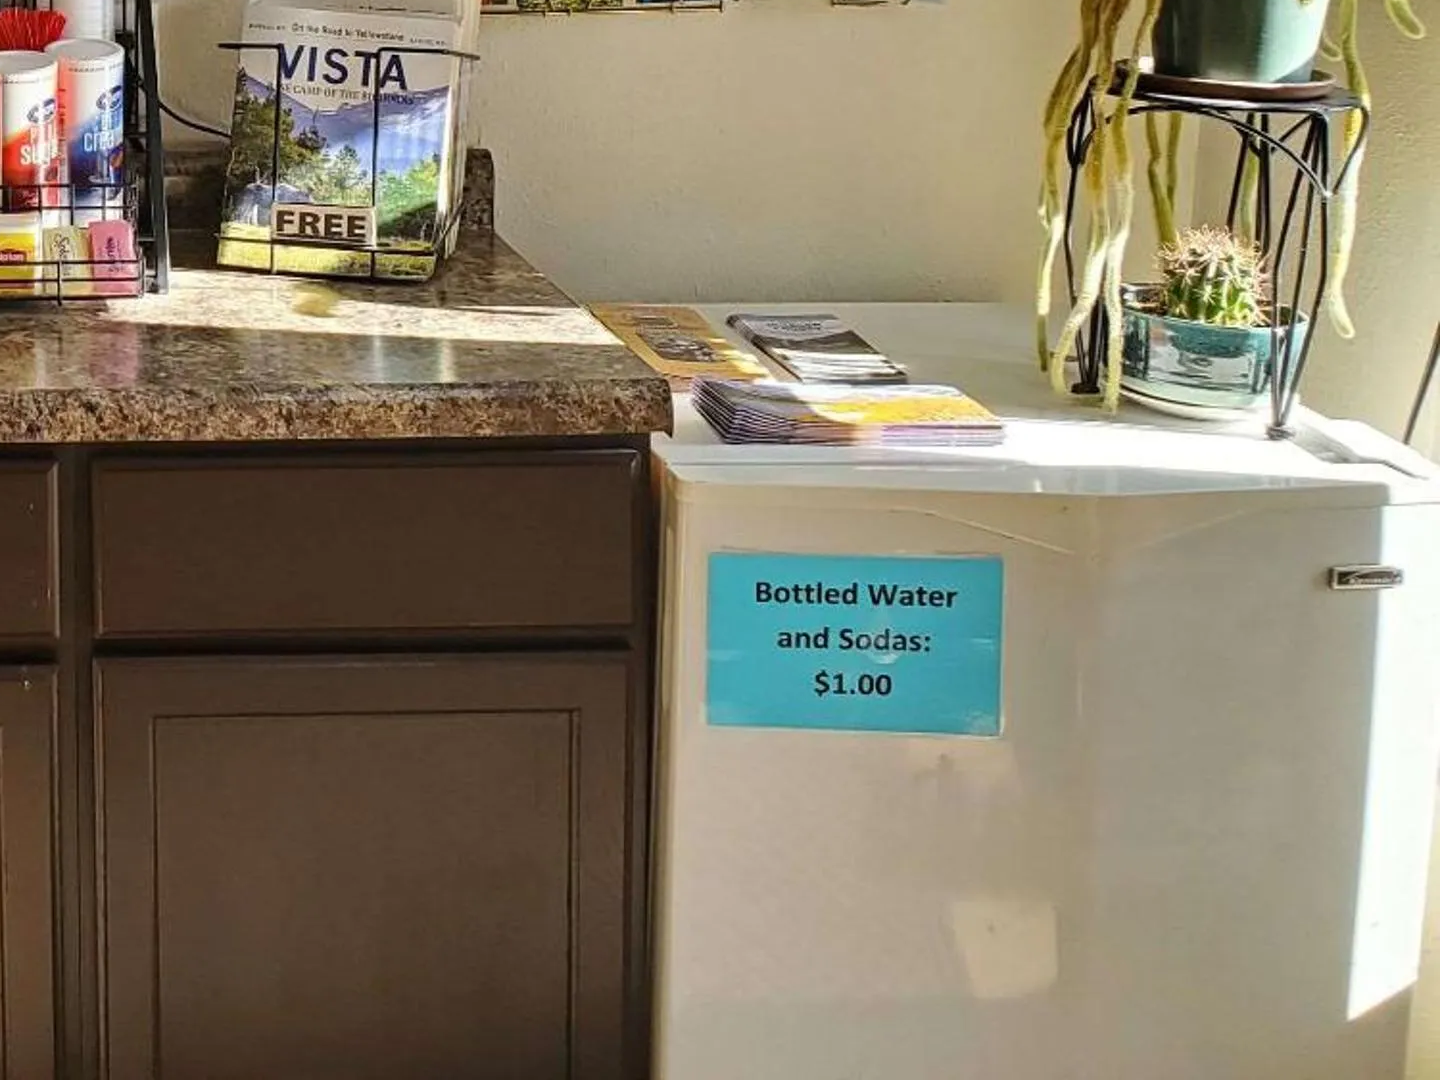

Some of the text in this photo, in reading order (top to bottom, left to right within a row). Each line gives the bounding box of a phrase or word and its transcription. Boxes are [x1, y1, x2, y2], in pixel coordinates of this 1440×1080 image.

[279, 42, 408, 90] VISTA
[276, 210, 366, 239] FREE
[755, 581, 958, 608] Bottled Water
[776, 626, 931, 652] and Sodas:
[814, 670, 892, 697] $1.00
